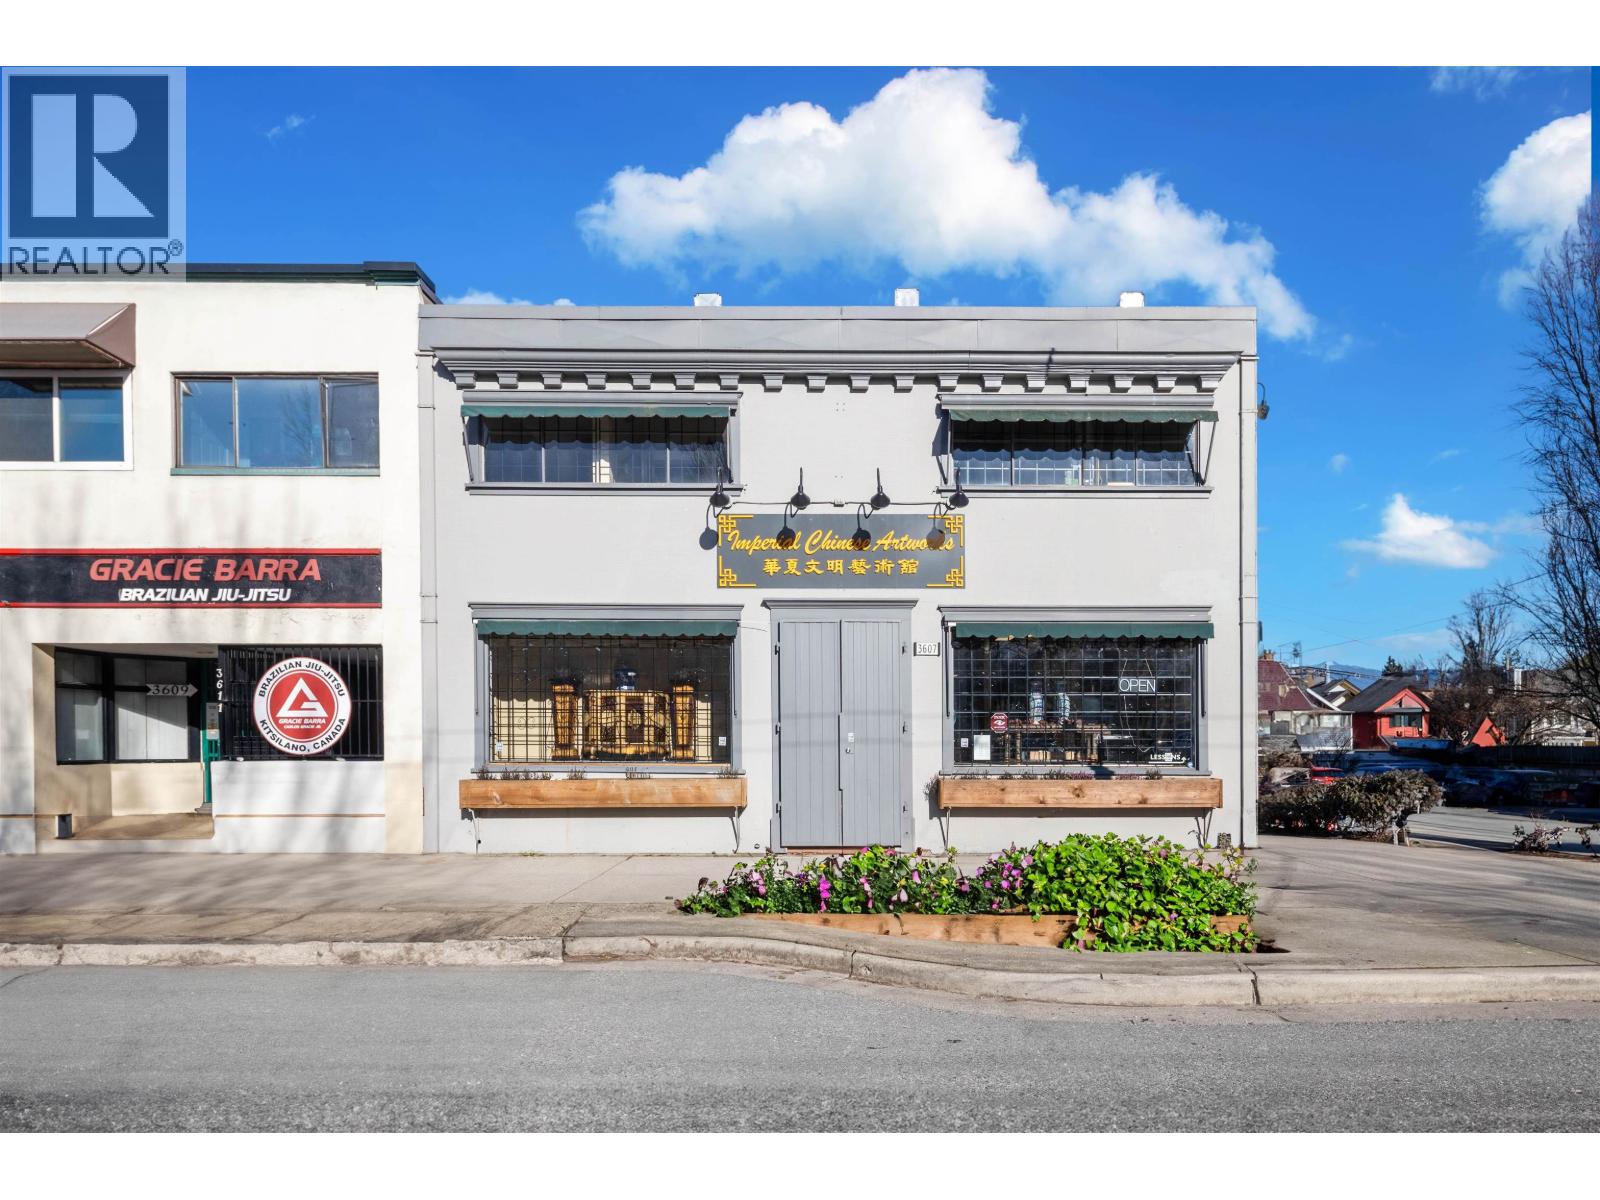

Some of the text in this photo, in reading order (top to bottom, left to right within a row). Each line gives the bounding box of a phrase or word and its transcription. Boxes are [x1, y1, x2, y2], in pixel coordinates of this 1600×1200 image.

[727, 529, 955, 556] Imperial Chinese Artwos
[89, 558, 321, 581] GRACIE BARRA
[119, 588, 292, 602] BRAZILIAN JIU-JITSU
[917, 643, 937, 654] 3607
[258, 660, 346, 698] BRAZILIAN JIU-JITSU
[1119, 678, 1156, 692] OPEN
[152, 685, 189, 696] 3609
[260, 717, 346, 752] KITSILANO, CANADA
